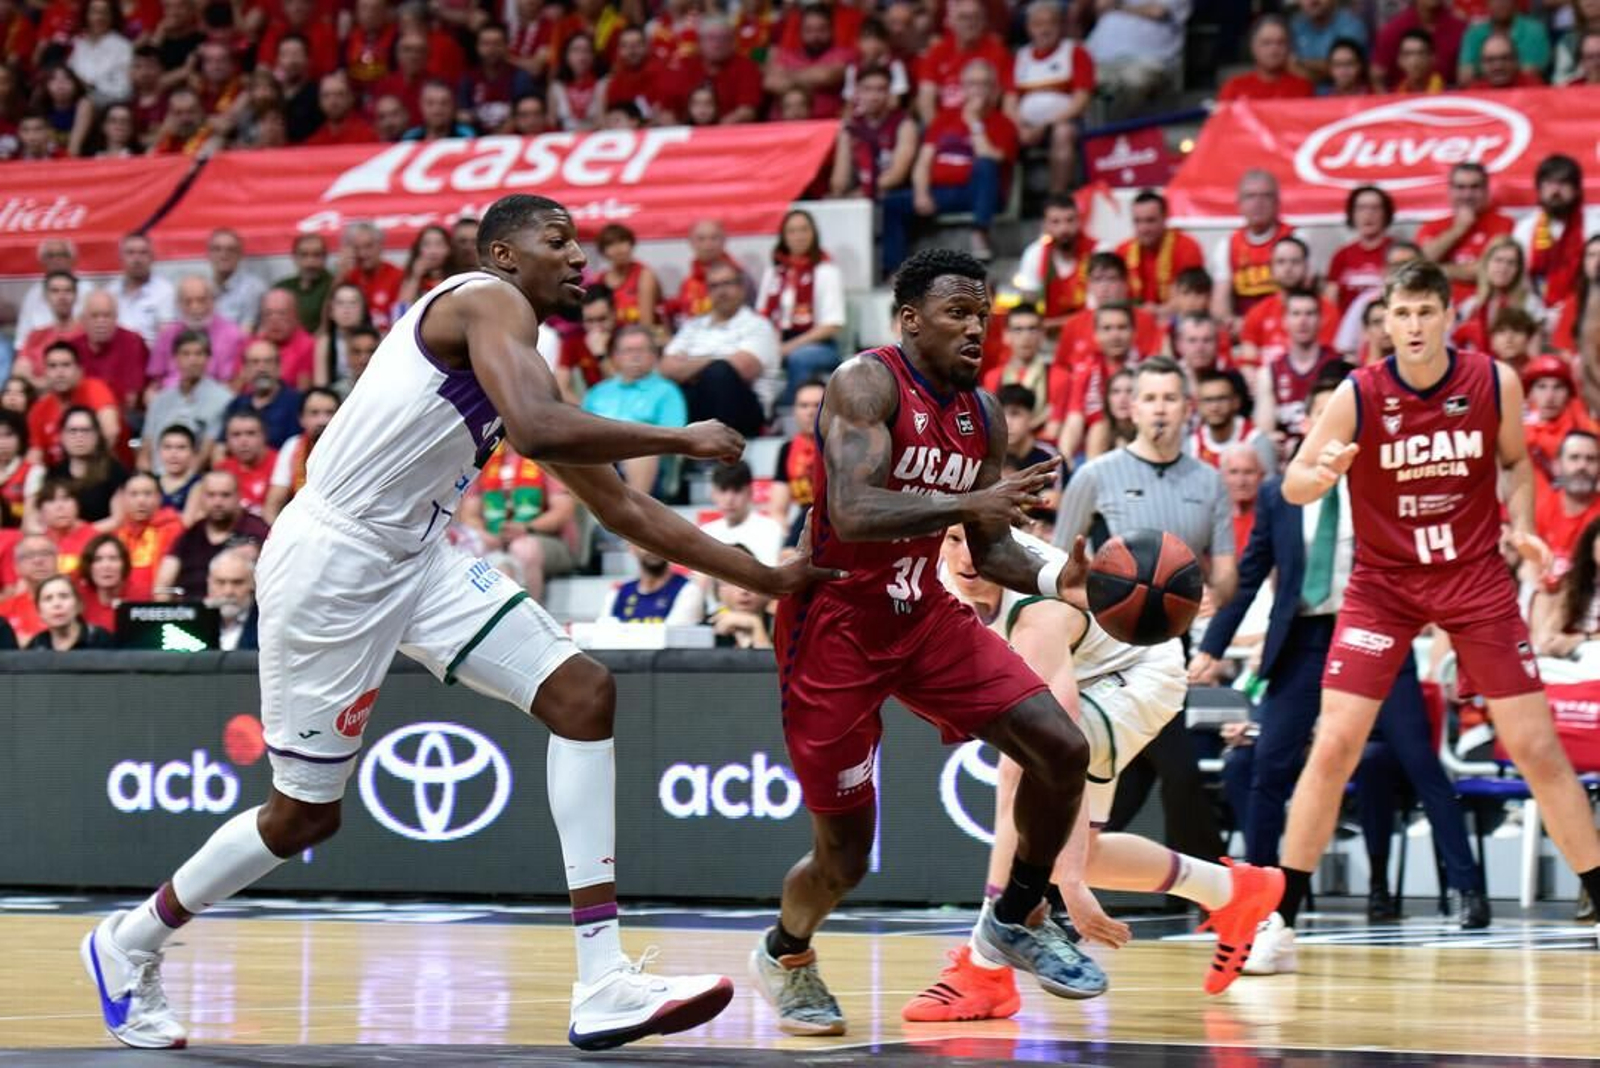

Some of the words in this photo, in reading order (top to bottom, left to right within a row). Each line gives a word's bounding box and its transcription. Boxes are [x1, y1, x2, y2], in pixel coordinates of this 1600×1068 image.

[401, 126, 692, 193] caser
[1320, 132, 1503, 168] Juver
[893, 446, 982, 491] UCAM
[1379, 429, 1484, 470] UCAM
[1396, 461, 1469, 482] MURCIA
[1413, 523, 1457, 564] 14
[886, 557, 928, 601] 31
[107, 748, 240, 814] acb
[658, 751, 802, 820] acb
